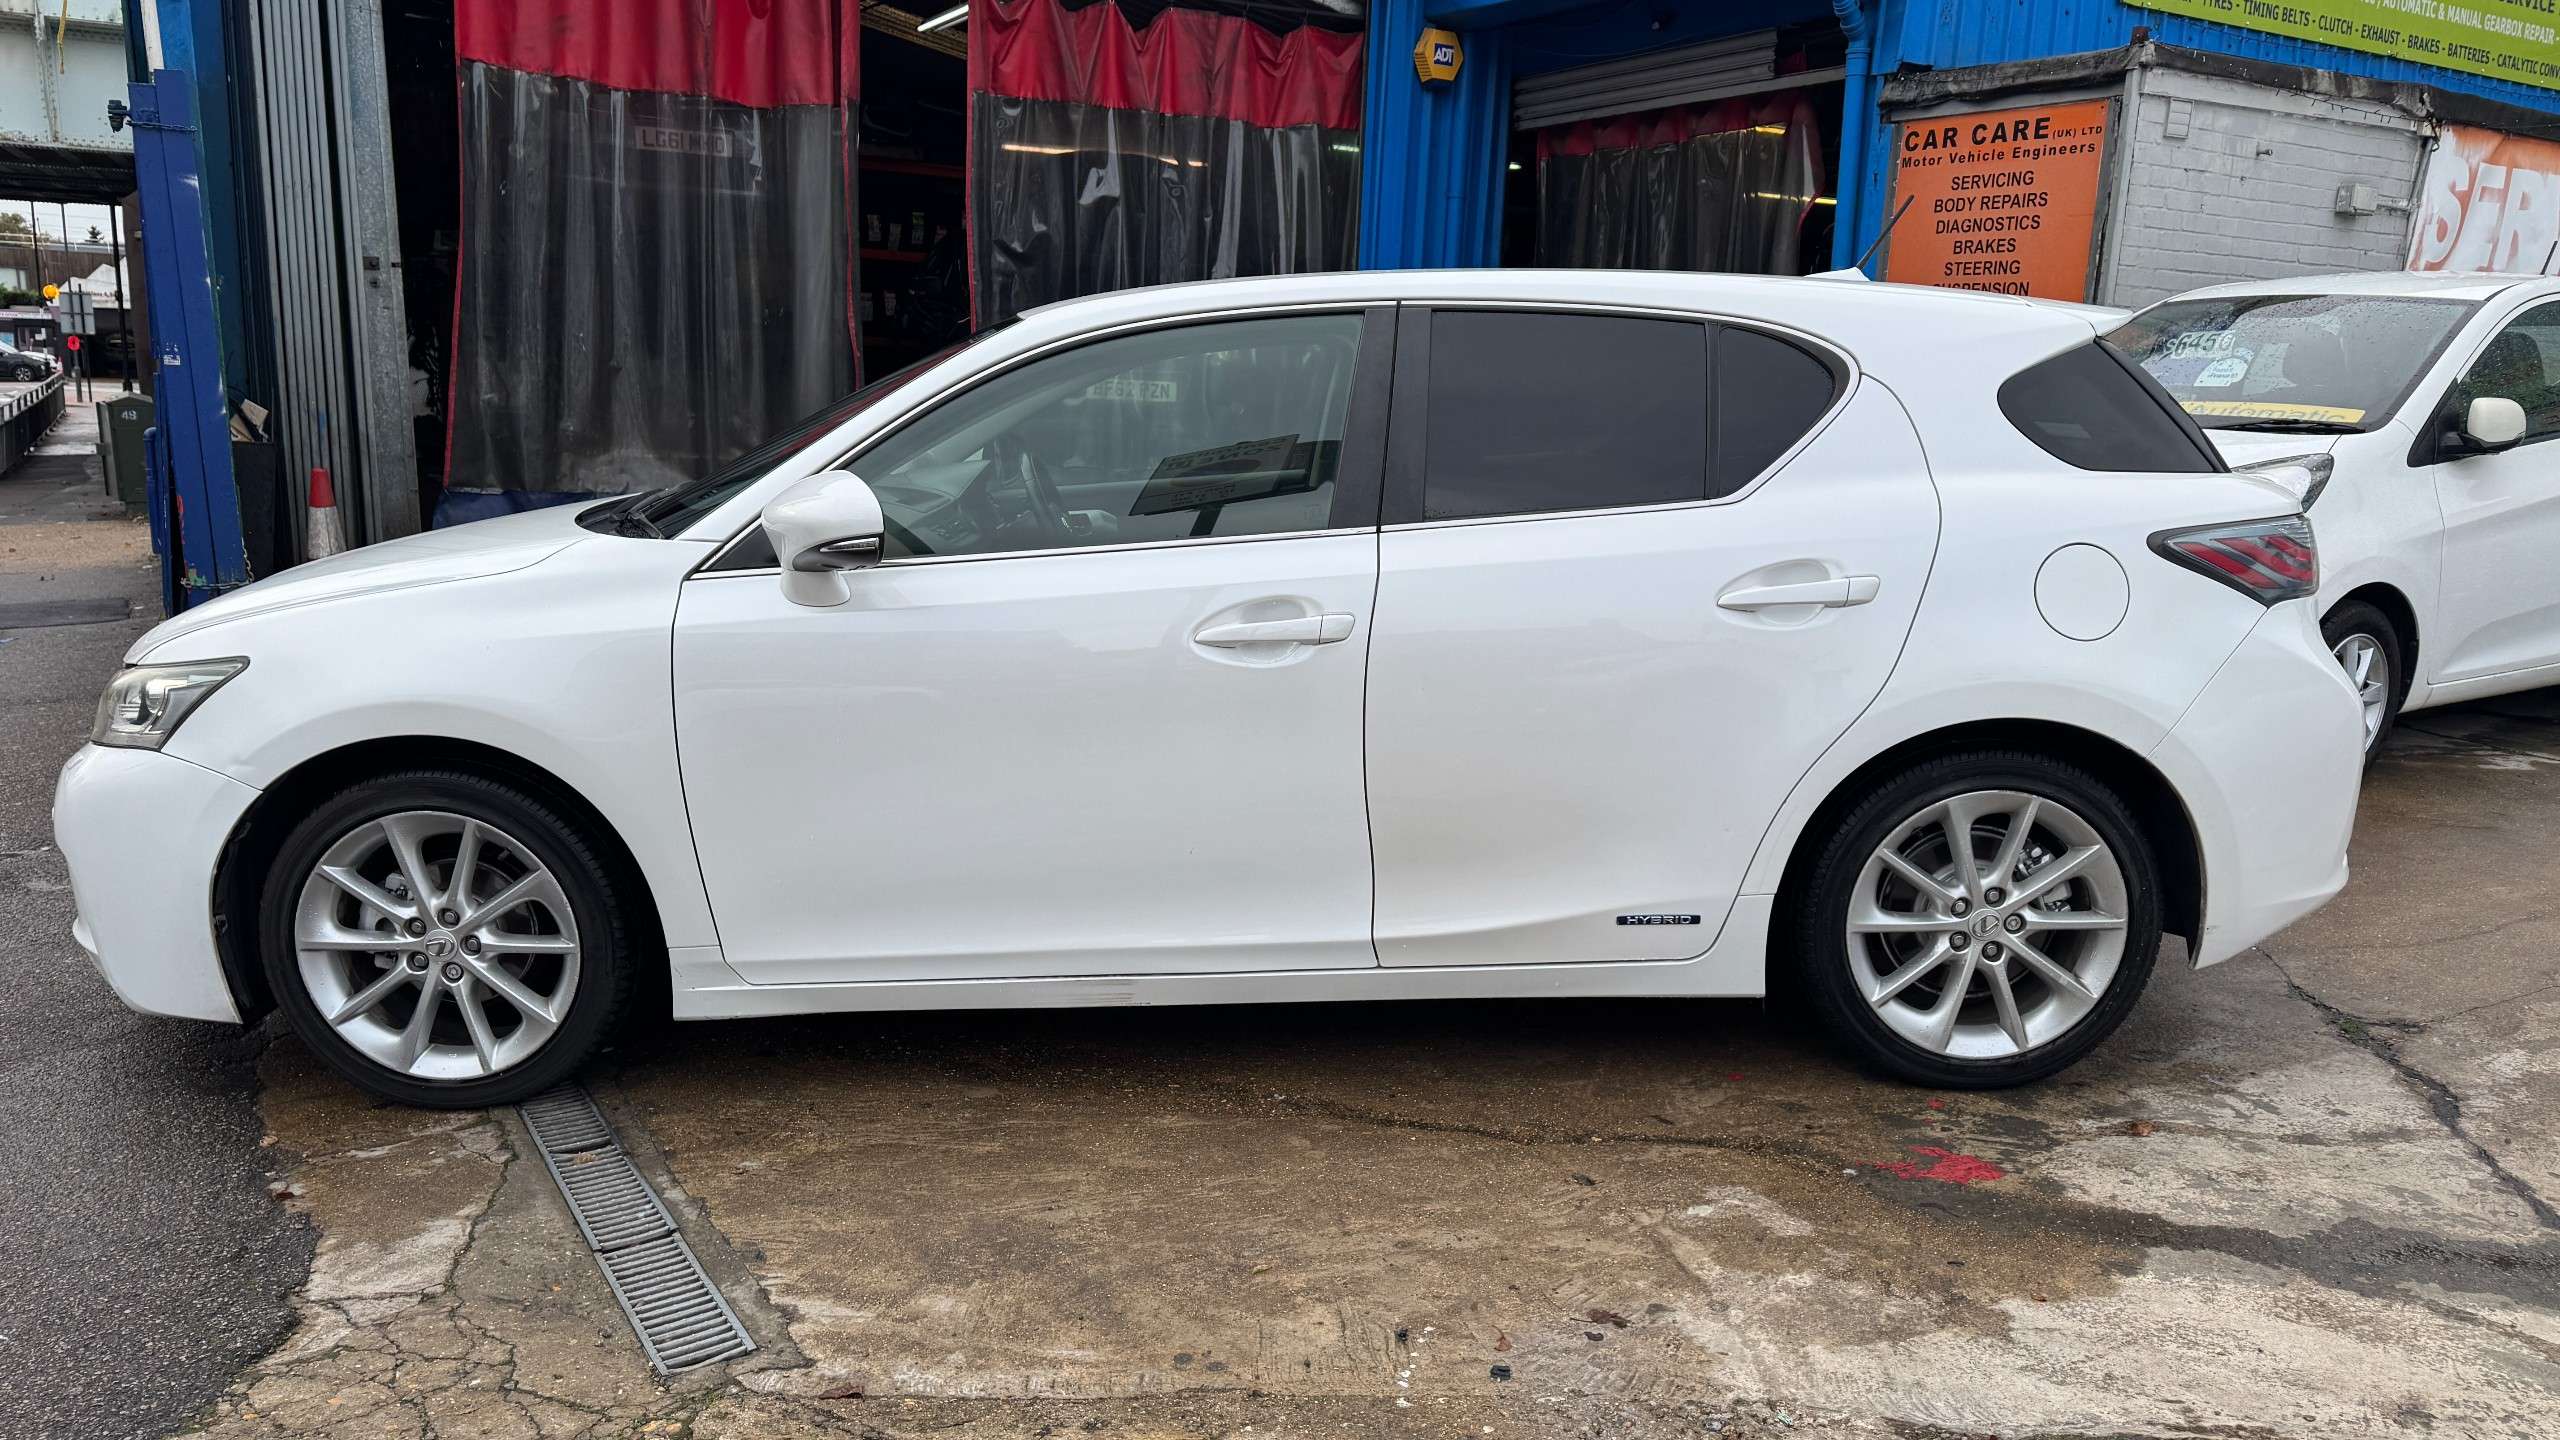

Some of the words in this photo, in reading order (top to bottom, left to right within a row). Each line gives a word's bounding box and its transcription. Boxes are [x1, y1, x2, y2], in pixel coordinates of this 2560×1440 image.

[2438, 7, 2445, 20] &
[2447, 6, 2482, 29] MANUAL
[2484, 14, 2524, 38] GEARBOX
[2525, 20, 2555, 44] REPAIR
[2243, 0, 2279, 20] TIMING
[2282, 7, 2310, 26] BELTS
[2318, 15, 2353, 36] CLUTCH
[2361, 24, 2400, 46] EXHAUST
[2408, 34, 2440, 54] BRAKES
[2448, 43, 2490, 65] BATTERIES
[2497, 54, 2539, 75] CATALYTIC
[1433, 47, 1455, 64] ADT
[1905, 127, 1958, 151] CAR
[1972, 117, 2050, 145] CARE
[2052, 127, 2077, 140] (UK)
[2081, 125, 2102, 136] LTD
[1902, 154, 1943, 168] Motor
[1949, 149, 2005, 164] Vehicle
[2012, 142, 2096, 160] Engineers
[1951, 170, 2034, 191] SERVICING
[1934, 196, 1976, 213] BODY
[1980, 192, 2048, 211] REPAIRS
[1935, 215, 2041, 234] DIAGNOSTICS
[1953, 238, 2017, 255] BRAKES
[1944, 260, 2021, 276] STEERING
[1626, 915, 1692, 924] HYBRID
